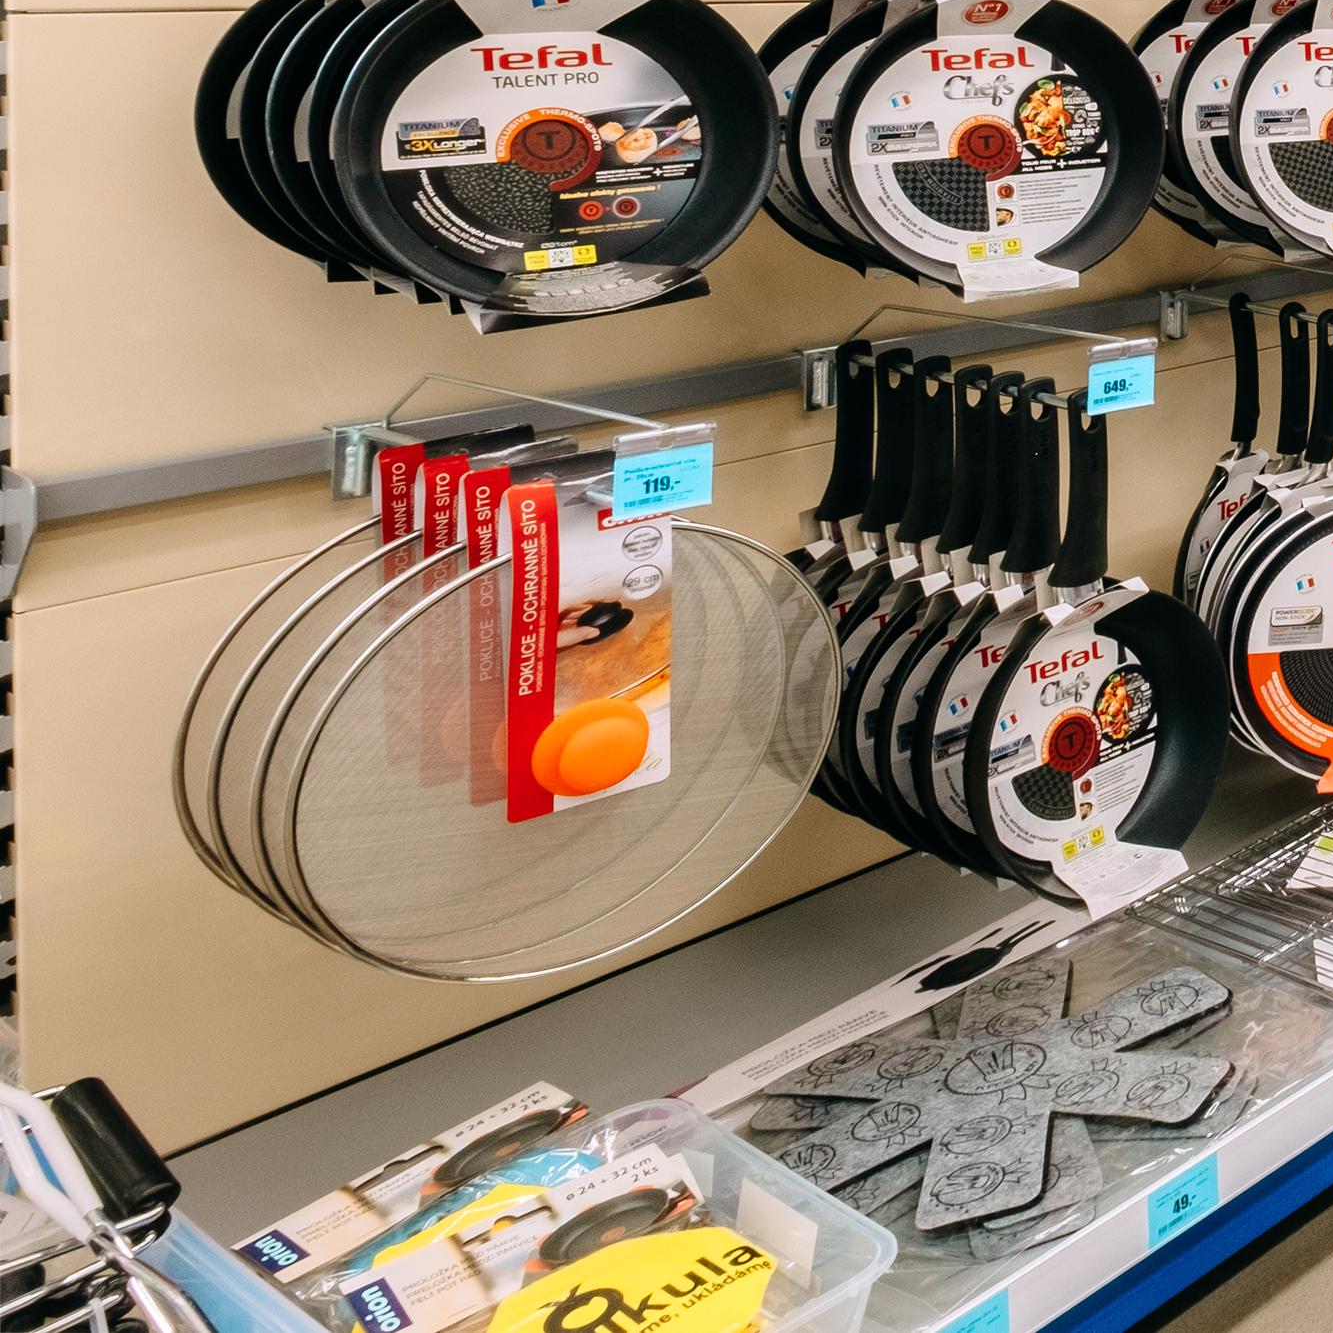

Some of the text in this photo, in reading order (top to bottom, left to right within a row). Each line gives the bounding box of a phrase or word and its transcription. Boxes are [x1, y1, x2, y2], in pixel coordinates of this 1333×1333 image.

[470, 43, 613, 72] Tefal
[921, 46, 1035, 72] Tefal
[492, 71, 600, 89] TALENT PRO
[403, 120, 461, 132] TITANIUM
[497, 114, 532, 158] EXCLUSIVE
[871, 125, 919, 133] TITANIUM
[411, 139, 435, 152] 3X
[871, 142, 888, 153] 2X
[1103, 378, 1134, 395] 649,-
[390, 462, 406, 495] SÍTO
[435, 472, 450, 508] SÍTO
[643, 475, 681, 494] 119,-
[475, 485, 491, 521] SÍTO
[518, 498, 538, 697] POKLICE OCHRANNÉ SÍTO
[1024, 640, 1104, 684] Tefal
[466, 1090, 541, 1134] 24 32 cm
[531, 1093, 549, 1107] ks
[578, 1156, 654, 1196] 24 32 cm
[632, 1165, 660, 1184] 2 ks
[1172, 1194, 1197, 1215] 49,-
[253, 1234, 299, 1267] orion
[358, 1284, 402, 1332] orion
